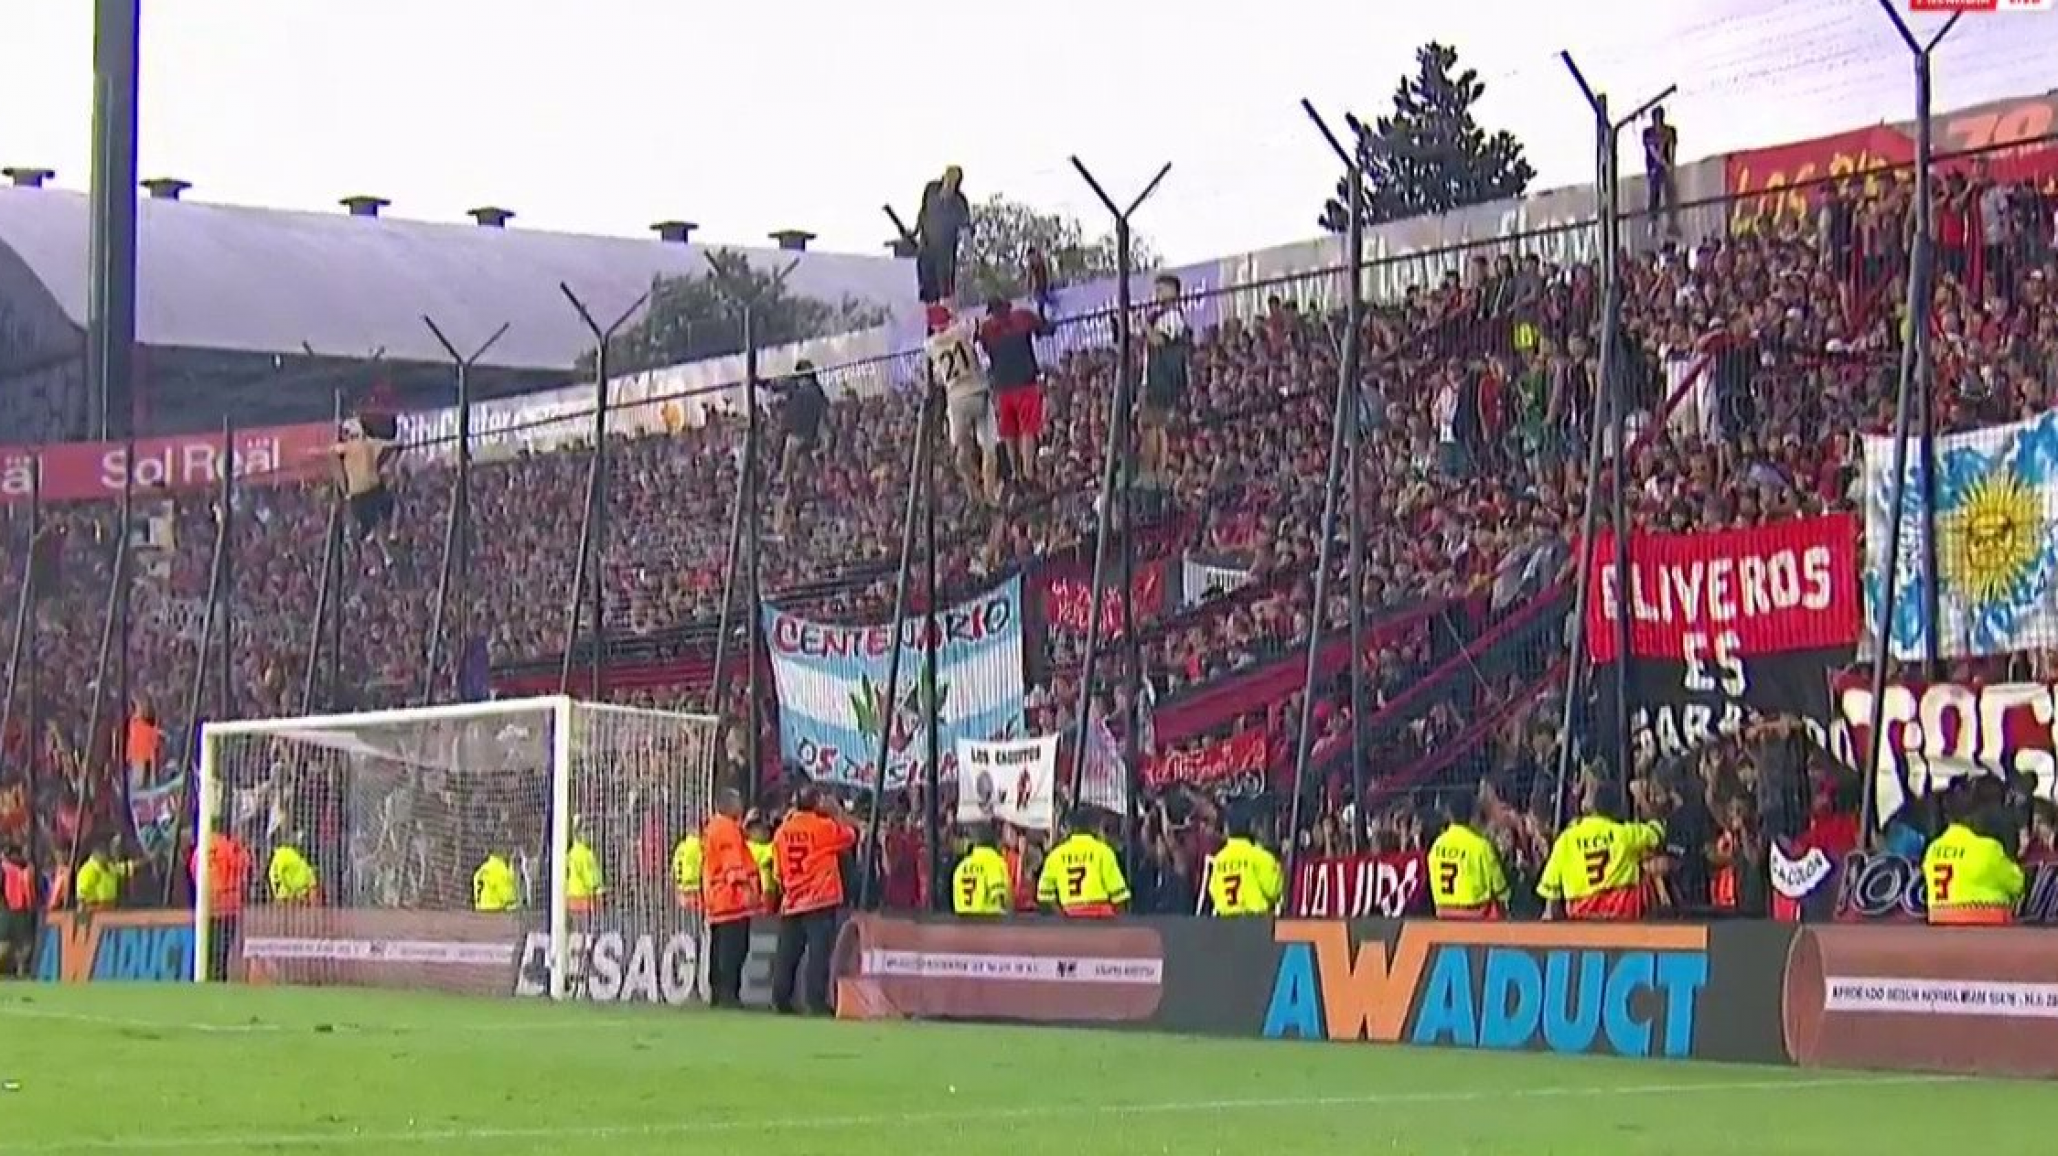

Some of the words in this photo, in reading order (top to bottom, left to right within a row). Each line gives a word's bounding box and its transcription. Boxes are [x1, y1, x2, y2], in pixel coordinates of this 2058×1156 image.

[939, 341, 969, 380] 21
[101, 446, 172, 489] Sol
[1683, 630, 1747, 697] ES
[1067, 867, 1087, 896] 3
[1440, 862, 1459, 894] 3
[1584, 850, 1611, 885] 3
[1934, 864, 1954, 900] 3
[1223, 875, 1242, 906] 3
[1263, 920, 1708, 1058] AWADUCT
